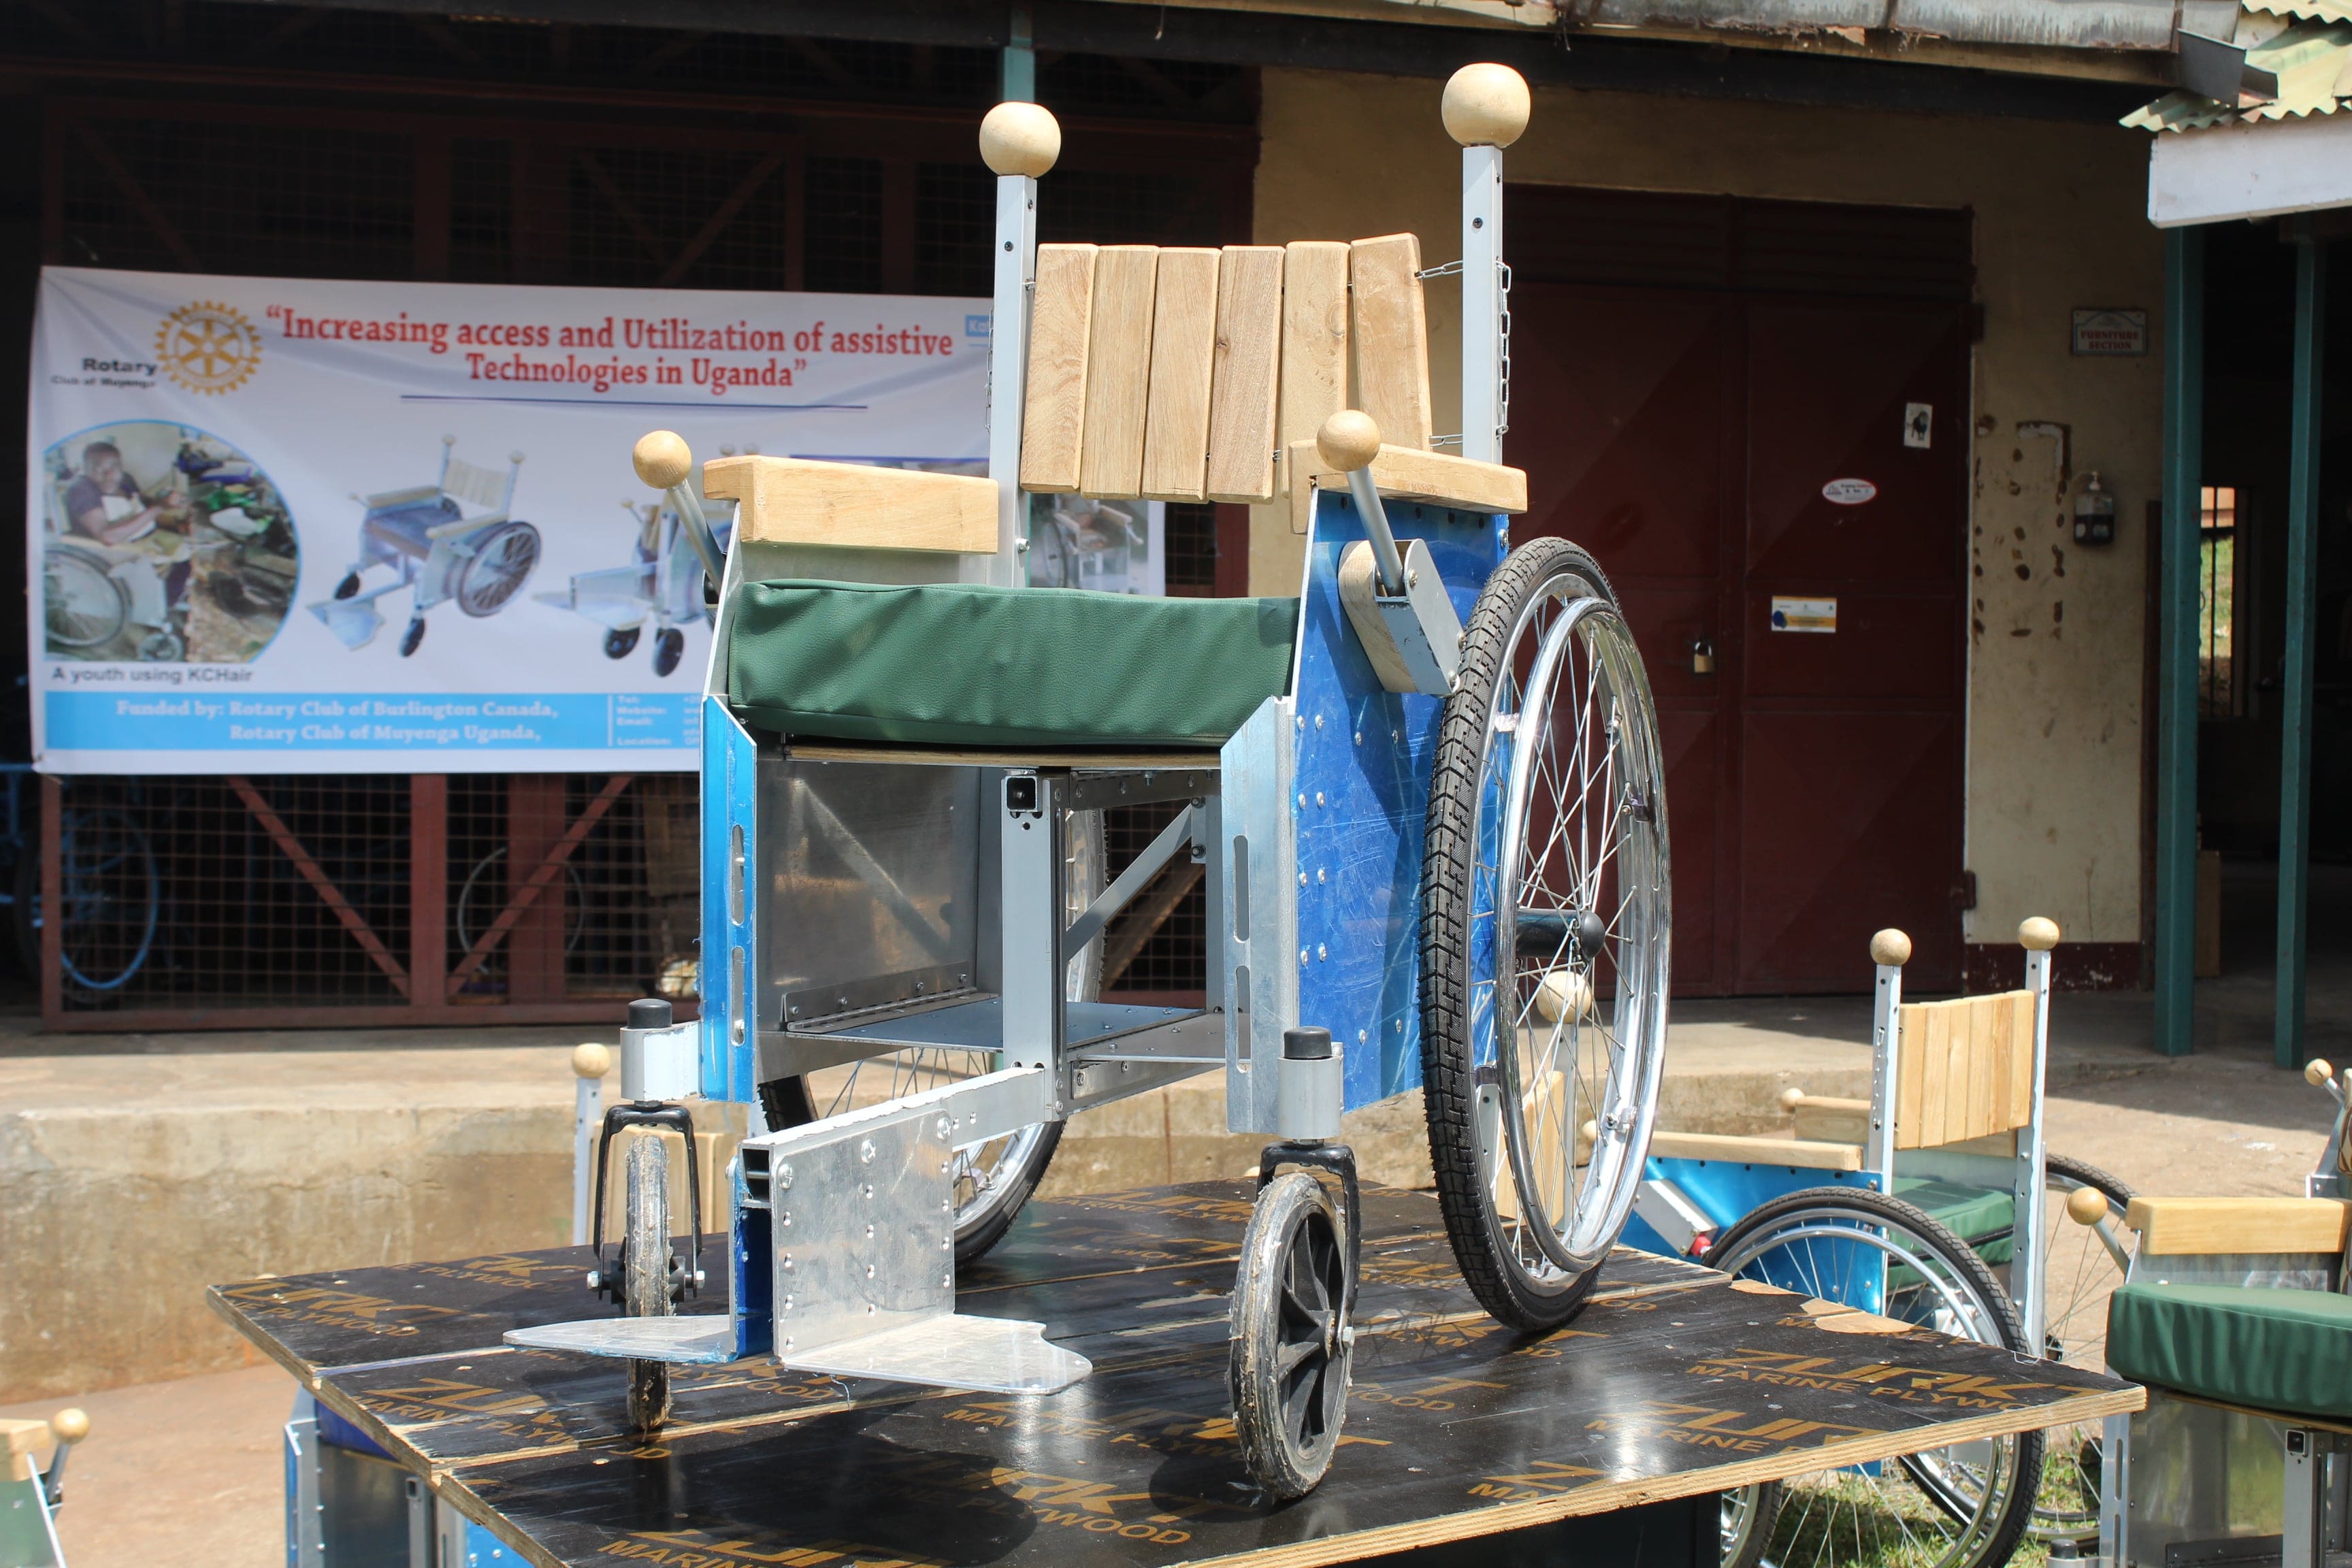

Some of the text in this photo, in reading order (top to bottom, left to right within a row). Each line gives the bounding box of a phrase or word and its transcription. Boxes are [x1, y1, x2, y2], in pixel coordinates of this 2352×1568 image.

[457, 324, 549, 347] access
[559, 316, 613, 348] and
[623, 317, 785, 351] Utilization
[794, 321, 825, 352] of
[831, 324, 953, 355] assistive
[2080, 331, 2138, 339] FURNITURE
[2089, 342, 2132, 350] SECTION
[82, 358, 158, 374] Rotary
[466, 353, 647, 393] Technologies
[657, 357, 683, 385] in
[52, 667, 254, 685] A youth using KCHair
[116, 700, 559, 720] Funded by: Rotary Club of Burlington Canada,
[229, 724, 542, 744] Rotary Club of Muyenga Uganda,
[270, 1306, 421, 1337] PLYWOOD
[1686, 1365, 2029, 1411] MARINE PLYWO
